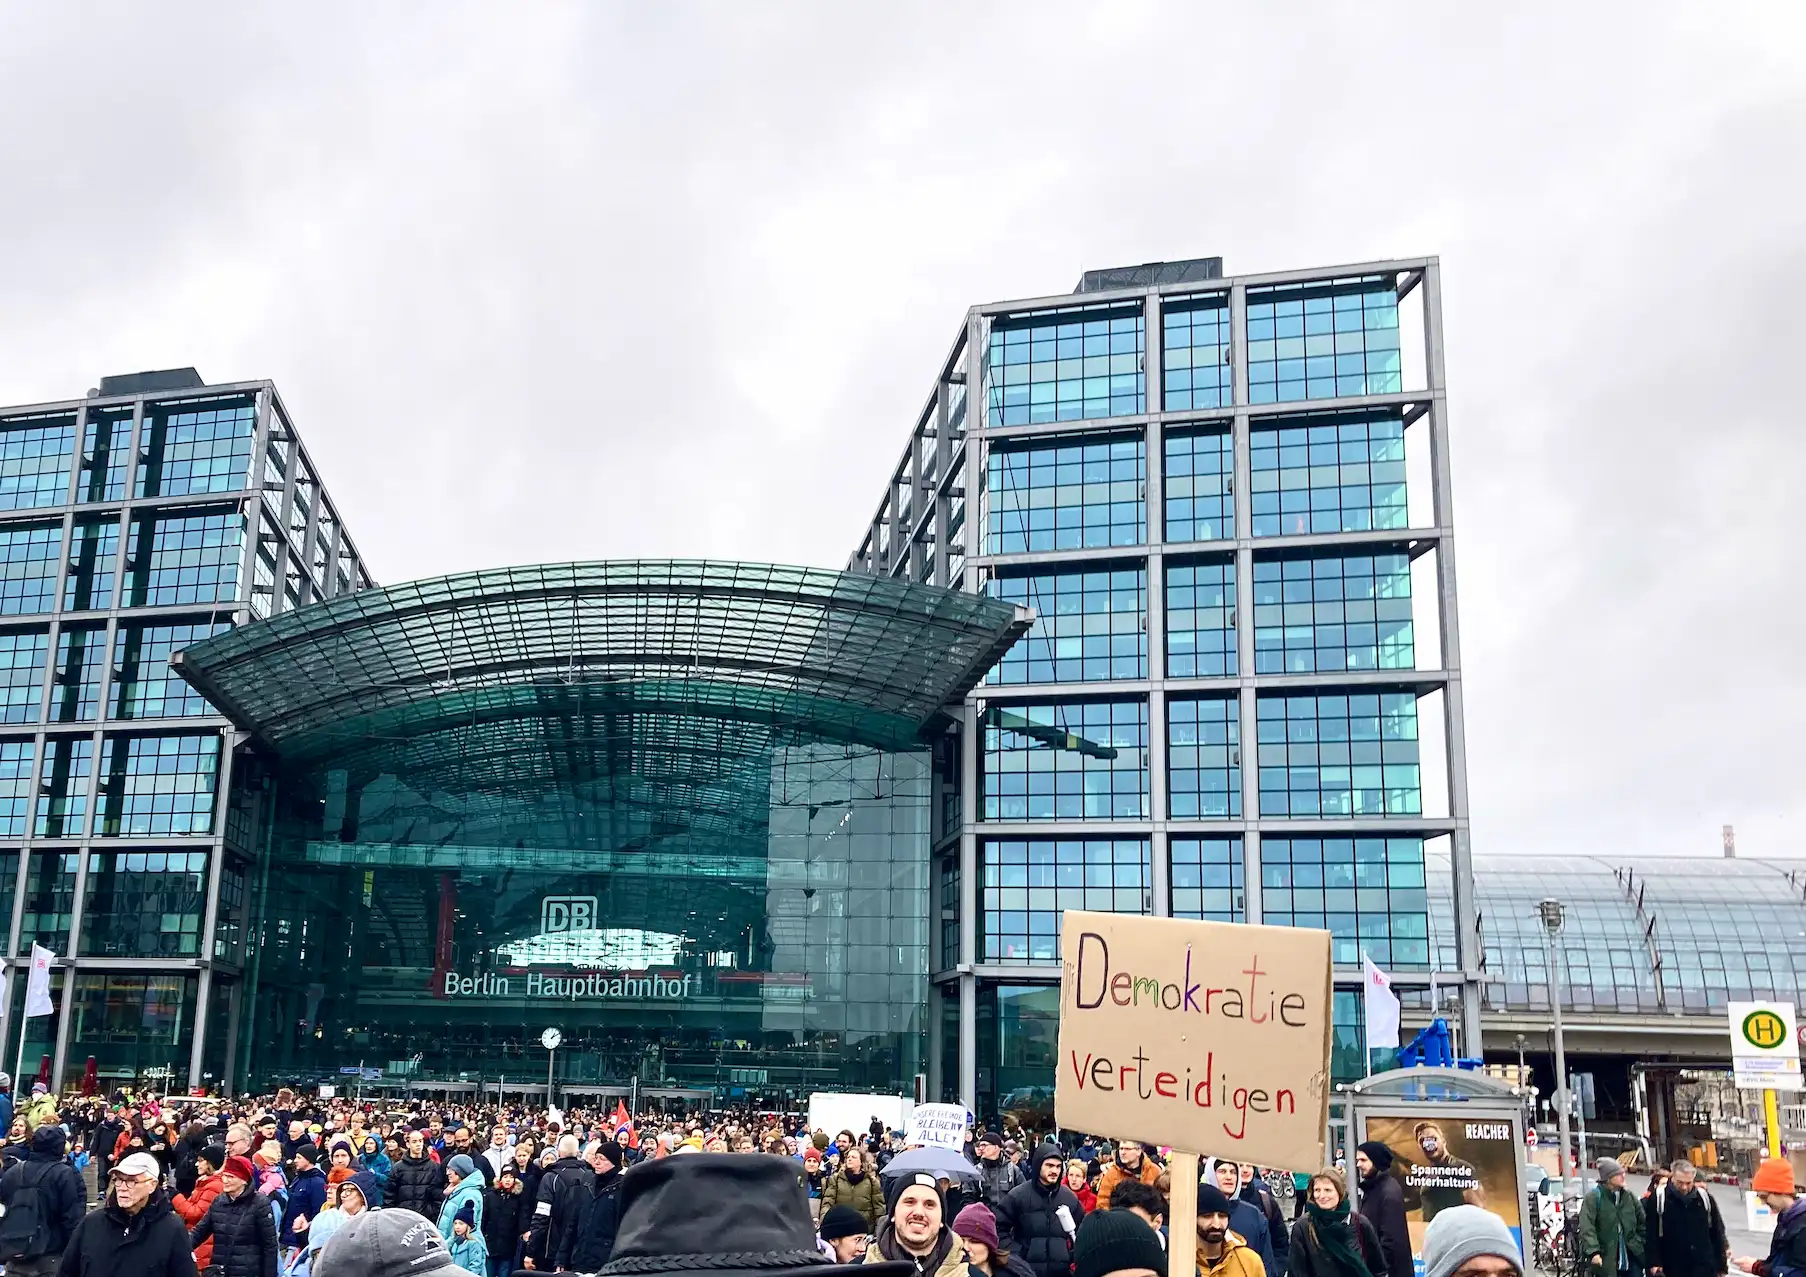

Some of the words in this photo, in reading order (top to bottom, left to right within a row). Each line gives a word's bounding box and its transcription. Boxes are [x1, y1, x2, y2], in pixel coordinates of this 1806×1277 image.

[549, 902, 591, 931] DB
[444, 972, 509, 996] Berlin
[526, 974, 691, 1001] Hauptbahnhof
[1076, 932, 1306, 1027] Demokratie
[1756, 1019, 1774, 1040] H
[1465, 1124, 1510, 1140] REACHER
[1411, 1164, 1472, 1176] Spannende
[1405, 1176, 1479, 1190] Unterhaltung
